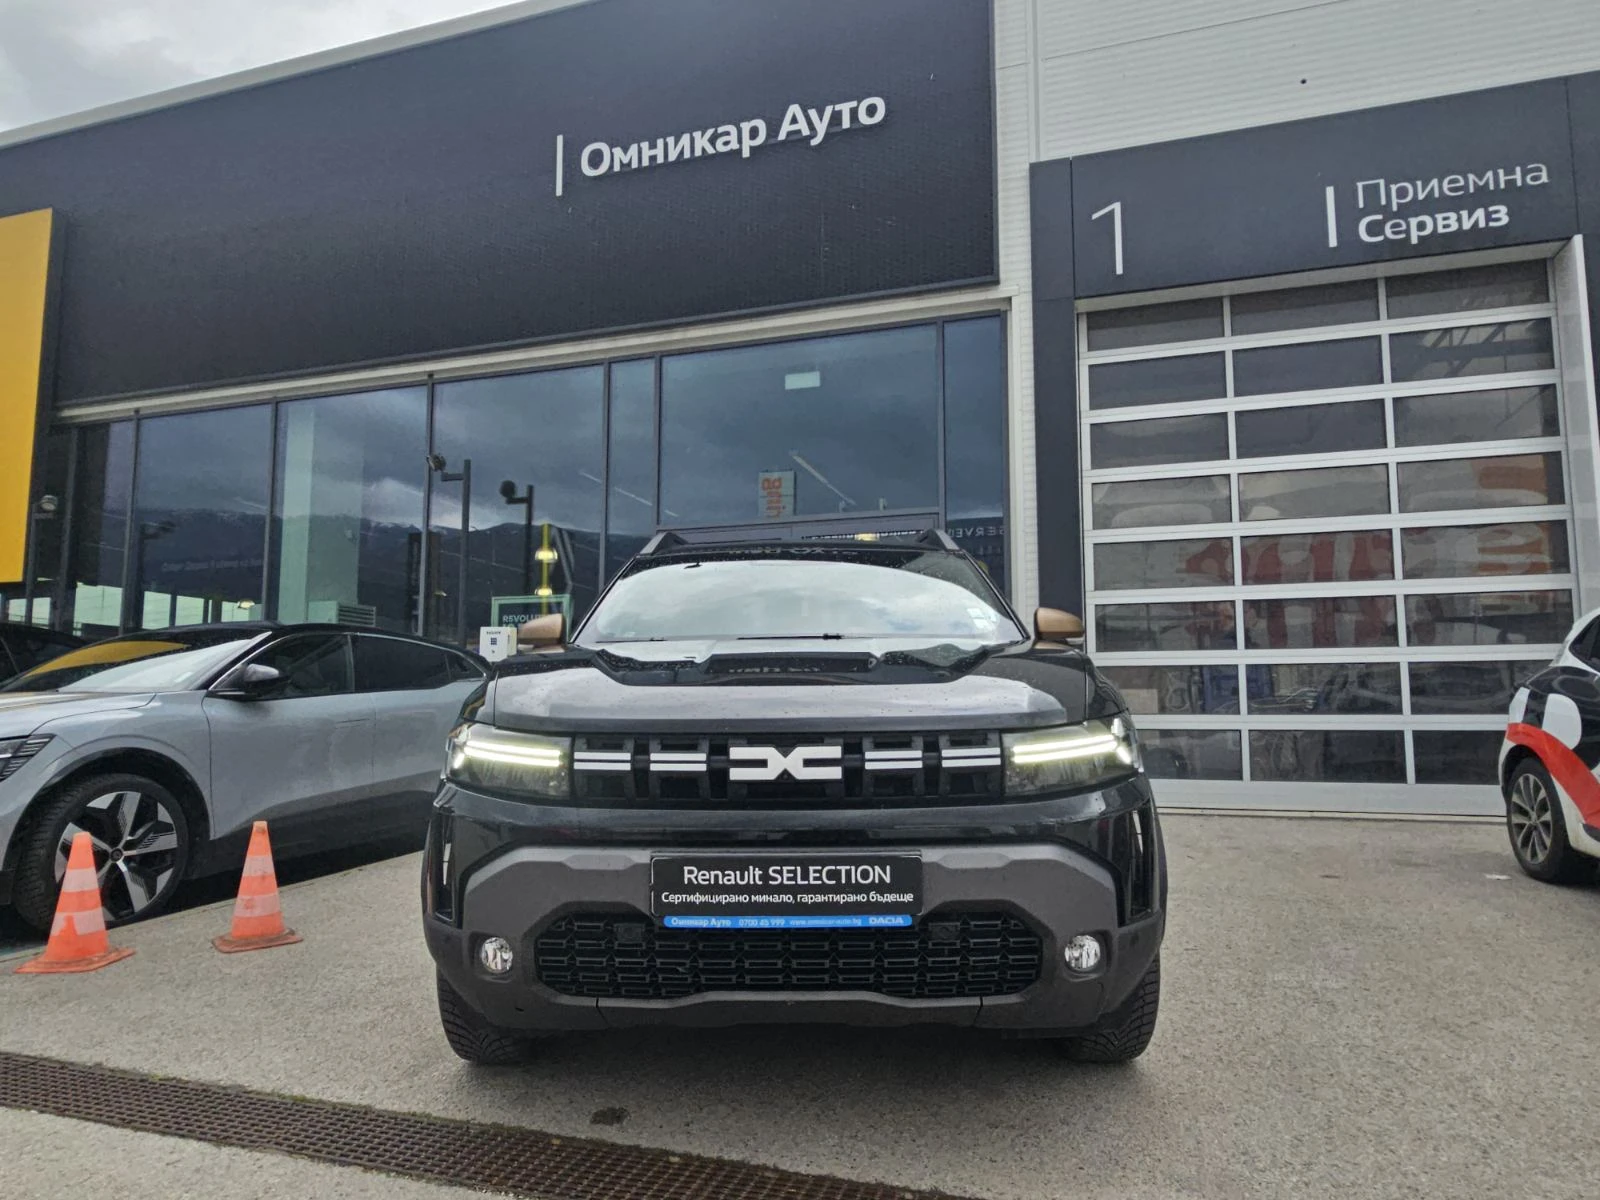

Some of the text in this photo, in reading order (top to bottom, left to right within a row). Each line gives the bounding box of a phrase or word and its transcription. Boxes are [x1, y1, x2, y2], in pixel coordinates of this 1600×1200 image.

[580, 96, 886, 177] Омникар Ауто
[1356, 163, 1550, 211] Приемна
[1091, 201, 1123, 275] 1
[1358, 204, 1510, 245] Сервиз
[683, 864, 892, 885] Renault SELECTION
[661, 891, 914, 905] Сертифицирано минало, гарантирано бъдеще
